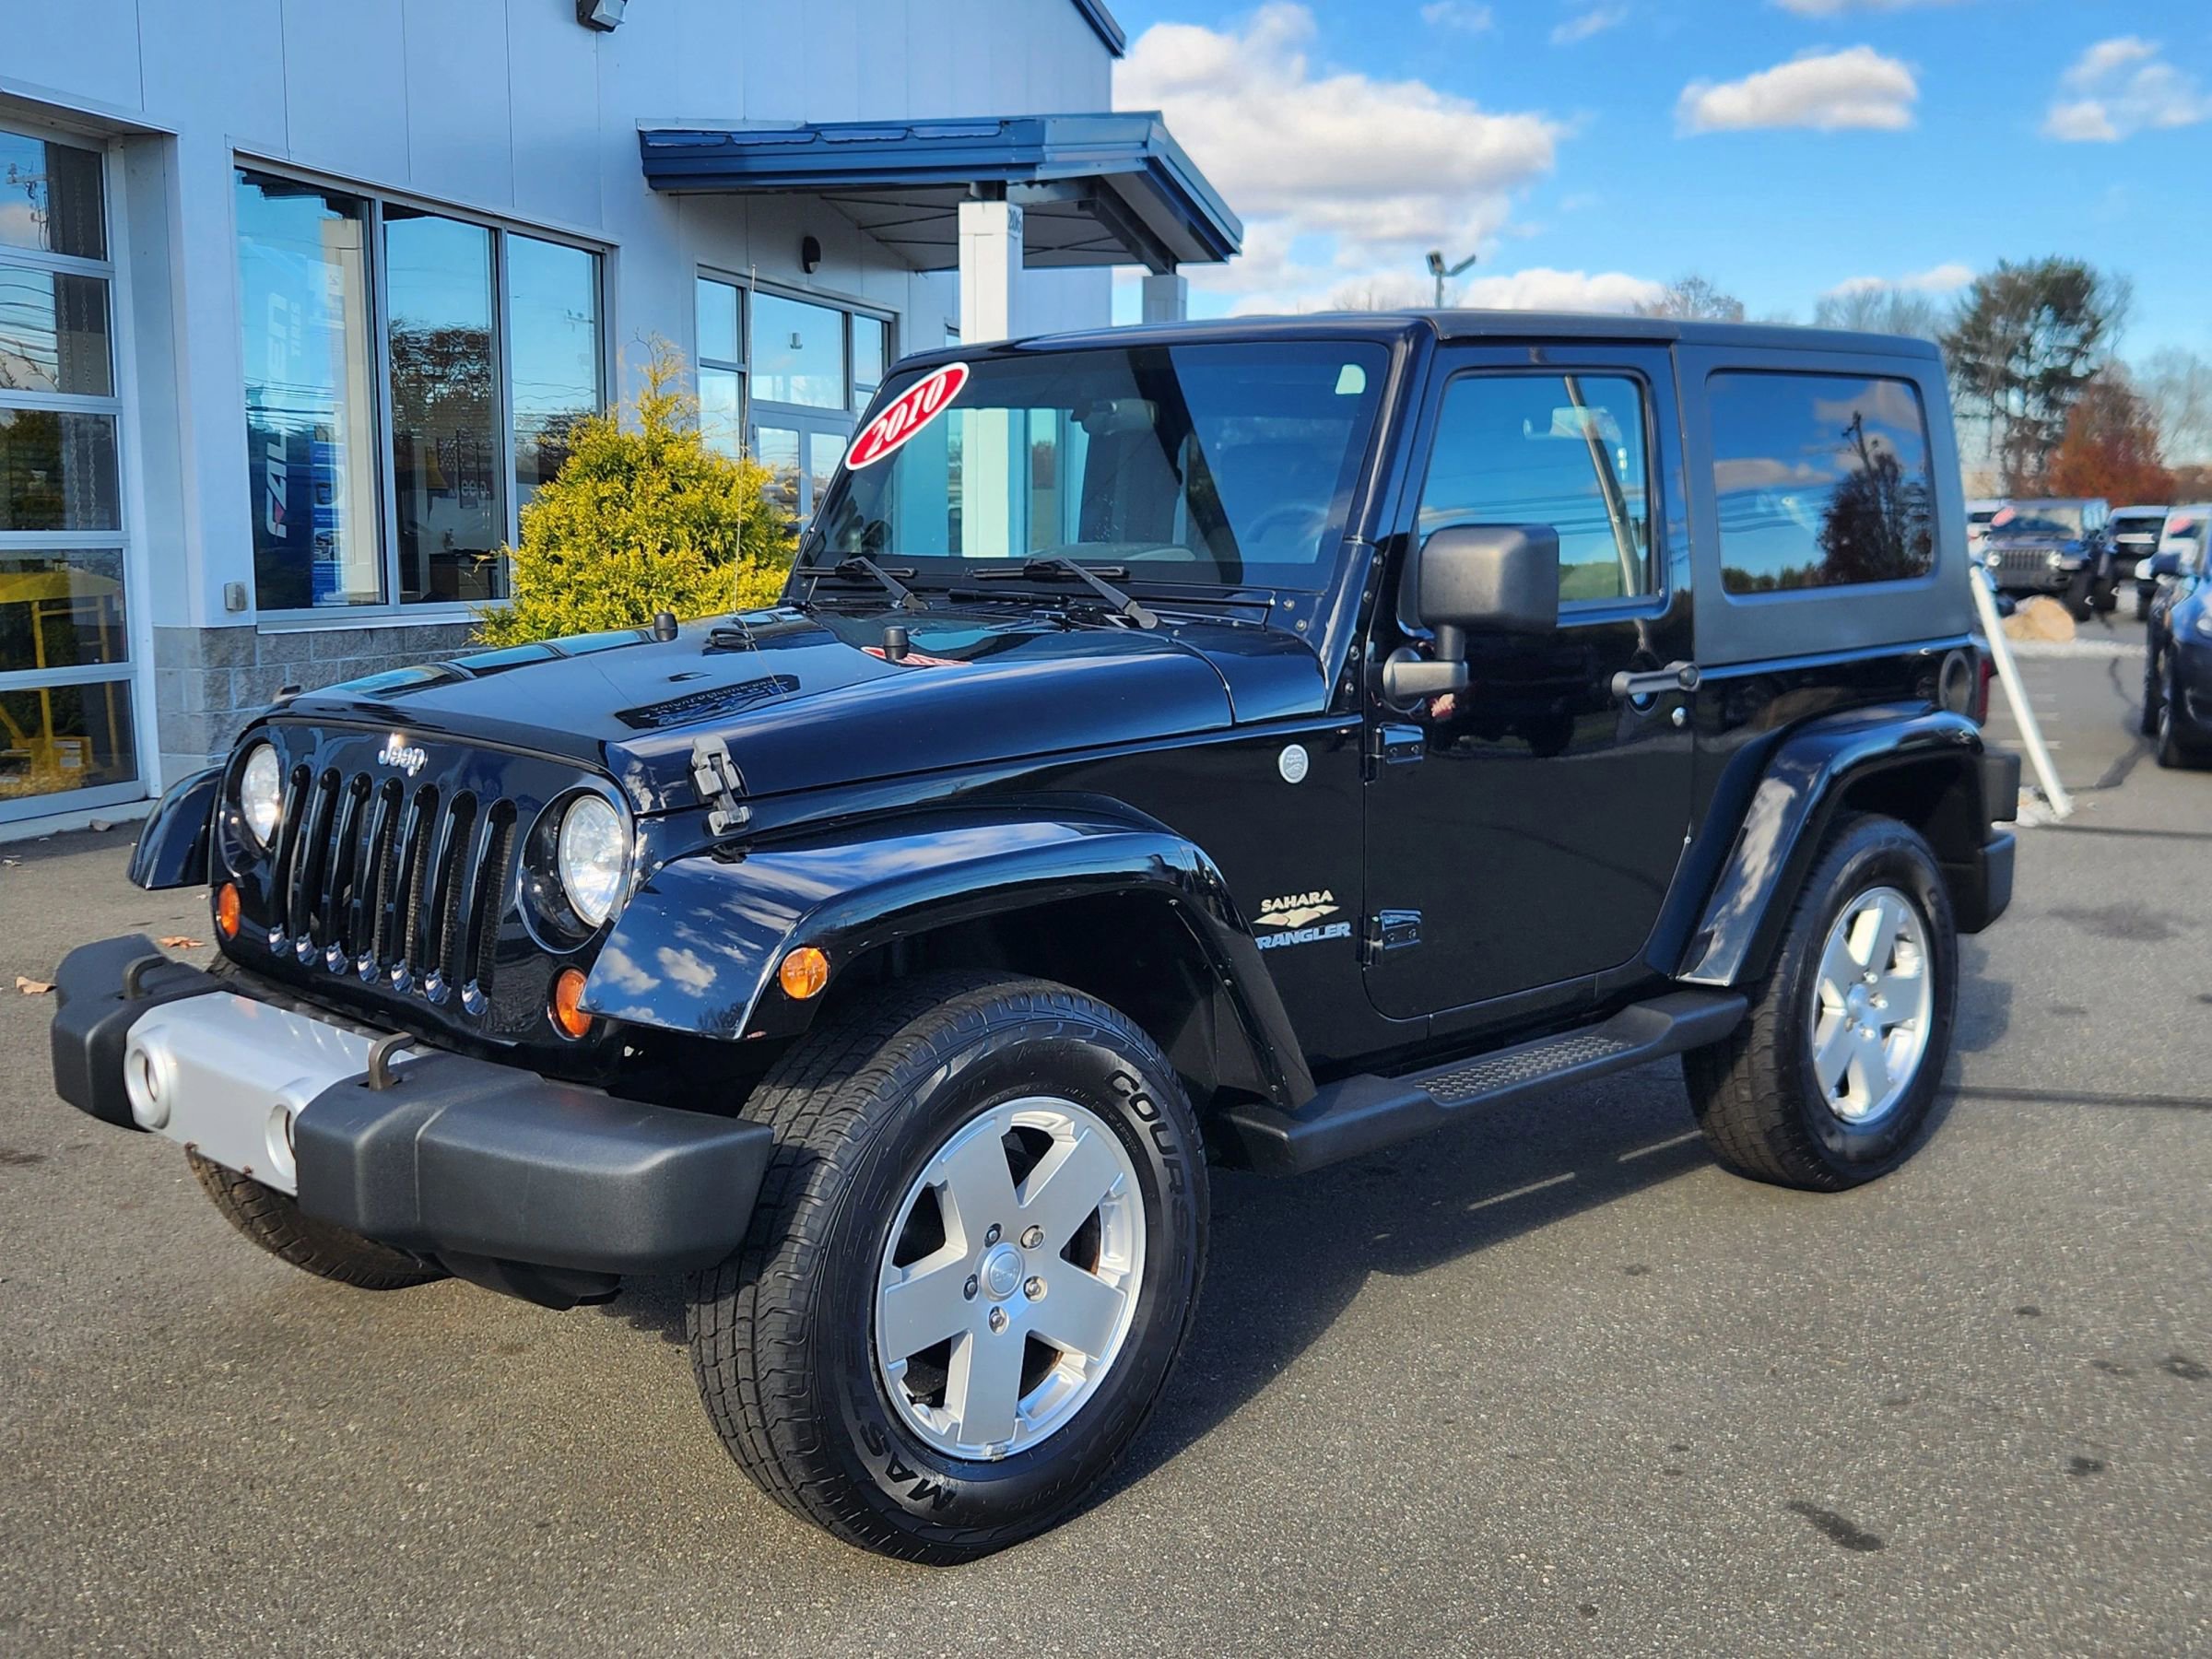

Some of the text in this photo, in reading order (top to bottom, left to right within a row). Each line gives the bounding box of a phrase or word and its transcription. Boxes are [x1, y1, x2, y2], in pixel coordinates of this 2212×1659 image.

[265, 292, 287, 538] FALEN
[864, 373, 947, 460] 2010
[378, 734, 426, 777] Jeep
[1261, 889, 1334, 912] SAHARA
[1254, 922, 1351, 950] RANGLER
